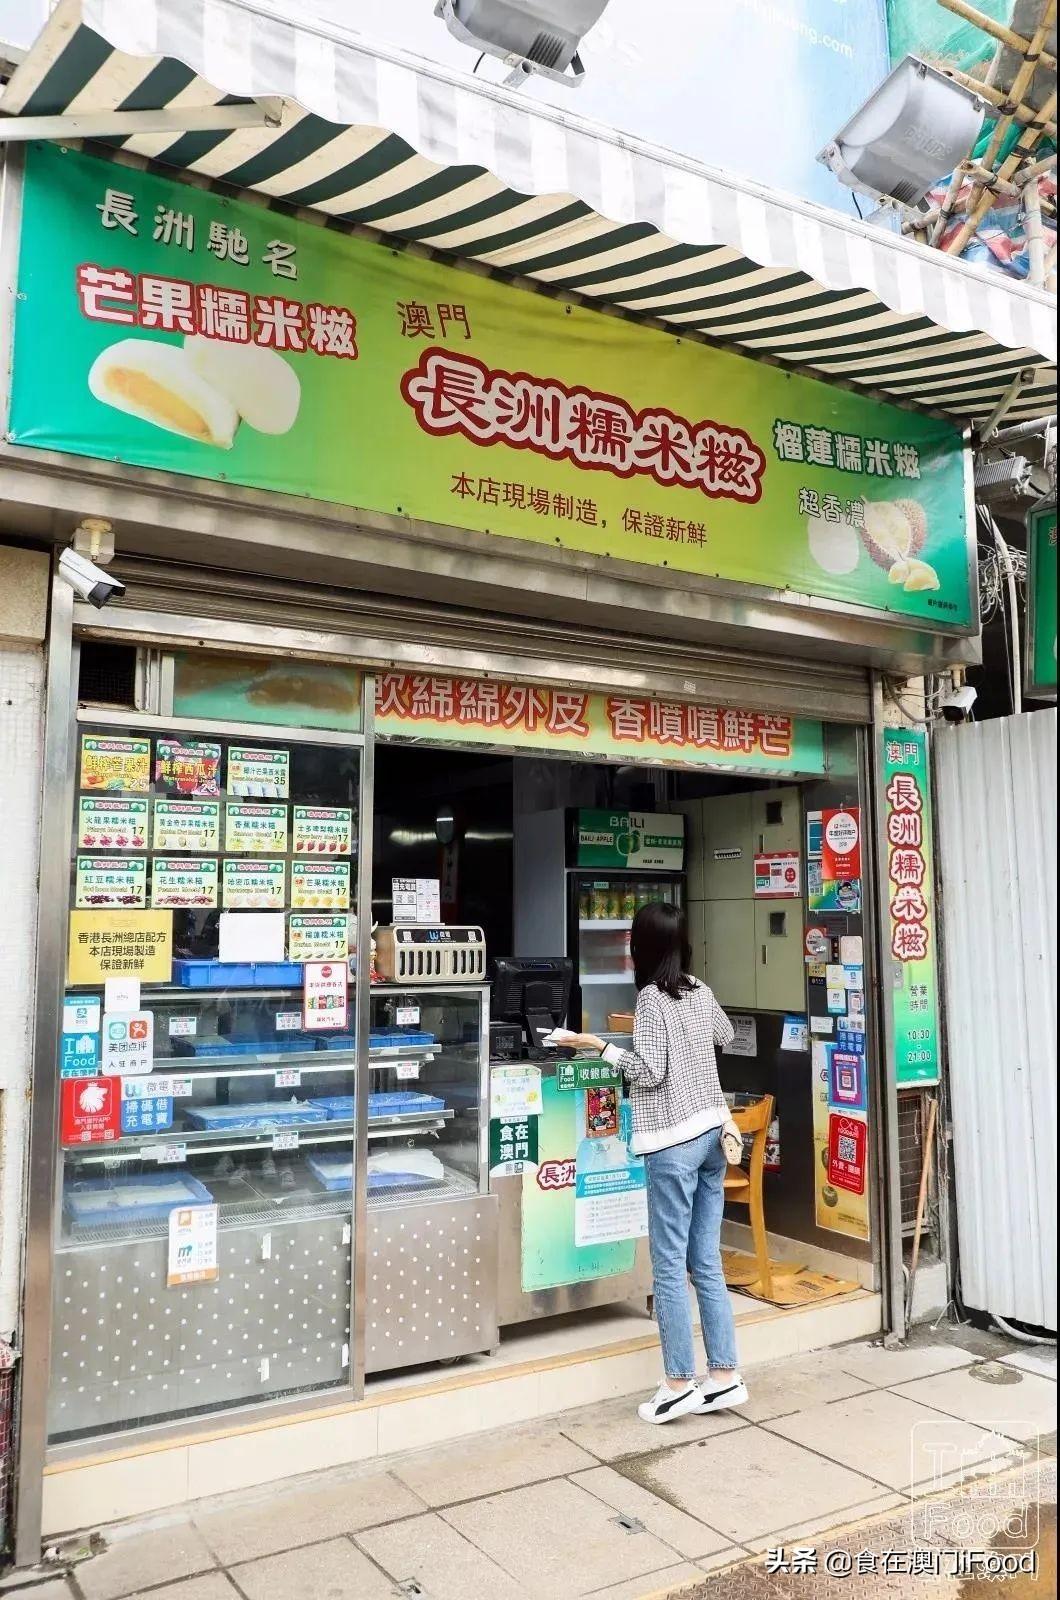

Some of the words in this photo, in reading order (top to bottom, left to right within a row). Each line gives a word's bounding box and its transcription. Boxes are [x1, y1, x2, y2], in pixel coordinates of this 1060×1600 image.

[97, 188, 298, 281] 長洲馳名
[77, 265, 359, 359] 芒果糯米糍
[397, 300, 472, 340] 澳門
[408, 355, 760, 497] 長洲糯米糍
[774, 420, 921, 480] 榴蓮糯米糍
[799, 487, 865, 529] 超香濃
[609, 699, 792, 754] 香噴噴鮮芒
[886, 740, 919, 765] 澳門
[160, 760, 218, 777] 鮮榨西瓜汁
[130, 779, 147, 790] 25
[274, 777, 286, 785] 35
[200, 783, 217, 793] 25
[609, 816, 645, 829] BAILI
[132, 826, 144, 835] 17
[204, 829, 216, 838] 17
[273, 831, 285, 840] 17
[338, 834, 349, 842] 17
[596, 835, 613, 843] APPLE
[888, 775, 927, 960] 長洲糯米糍
[129, 885, 143, 895] 17
[201, 886, 214, 895] 17
[270, 886, 282, 895] 17
[335, 887, 347, 896] 17
[78, 932, 167, 944] 香港長洲總店配方
[334, 940, 346, 949] 17
[89, 945, 156, 957] 本店現場製造
[99, 958, 145, 971] 保證新鮮
[910, 998, 928, 1011] 時間
[908, 1029, 930, 1040] 10:30
[108, 1040, 147, 1053] 美团点评
[64, 1055, 96, 1068] Food
[908, 1051, 931, 1062] 21:00
[560, 1075, 575, 1083] Food
[125, 1113, 168, 1128] 充電寶
[500, 1123, 529, 1141] 食在
[500, 1142, 529, 1161] 澳門
